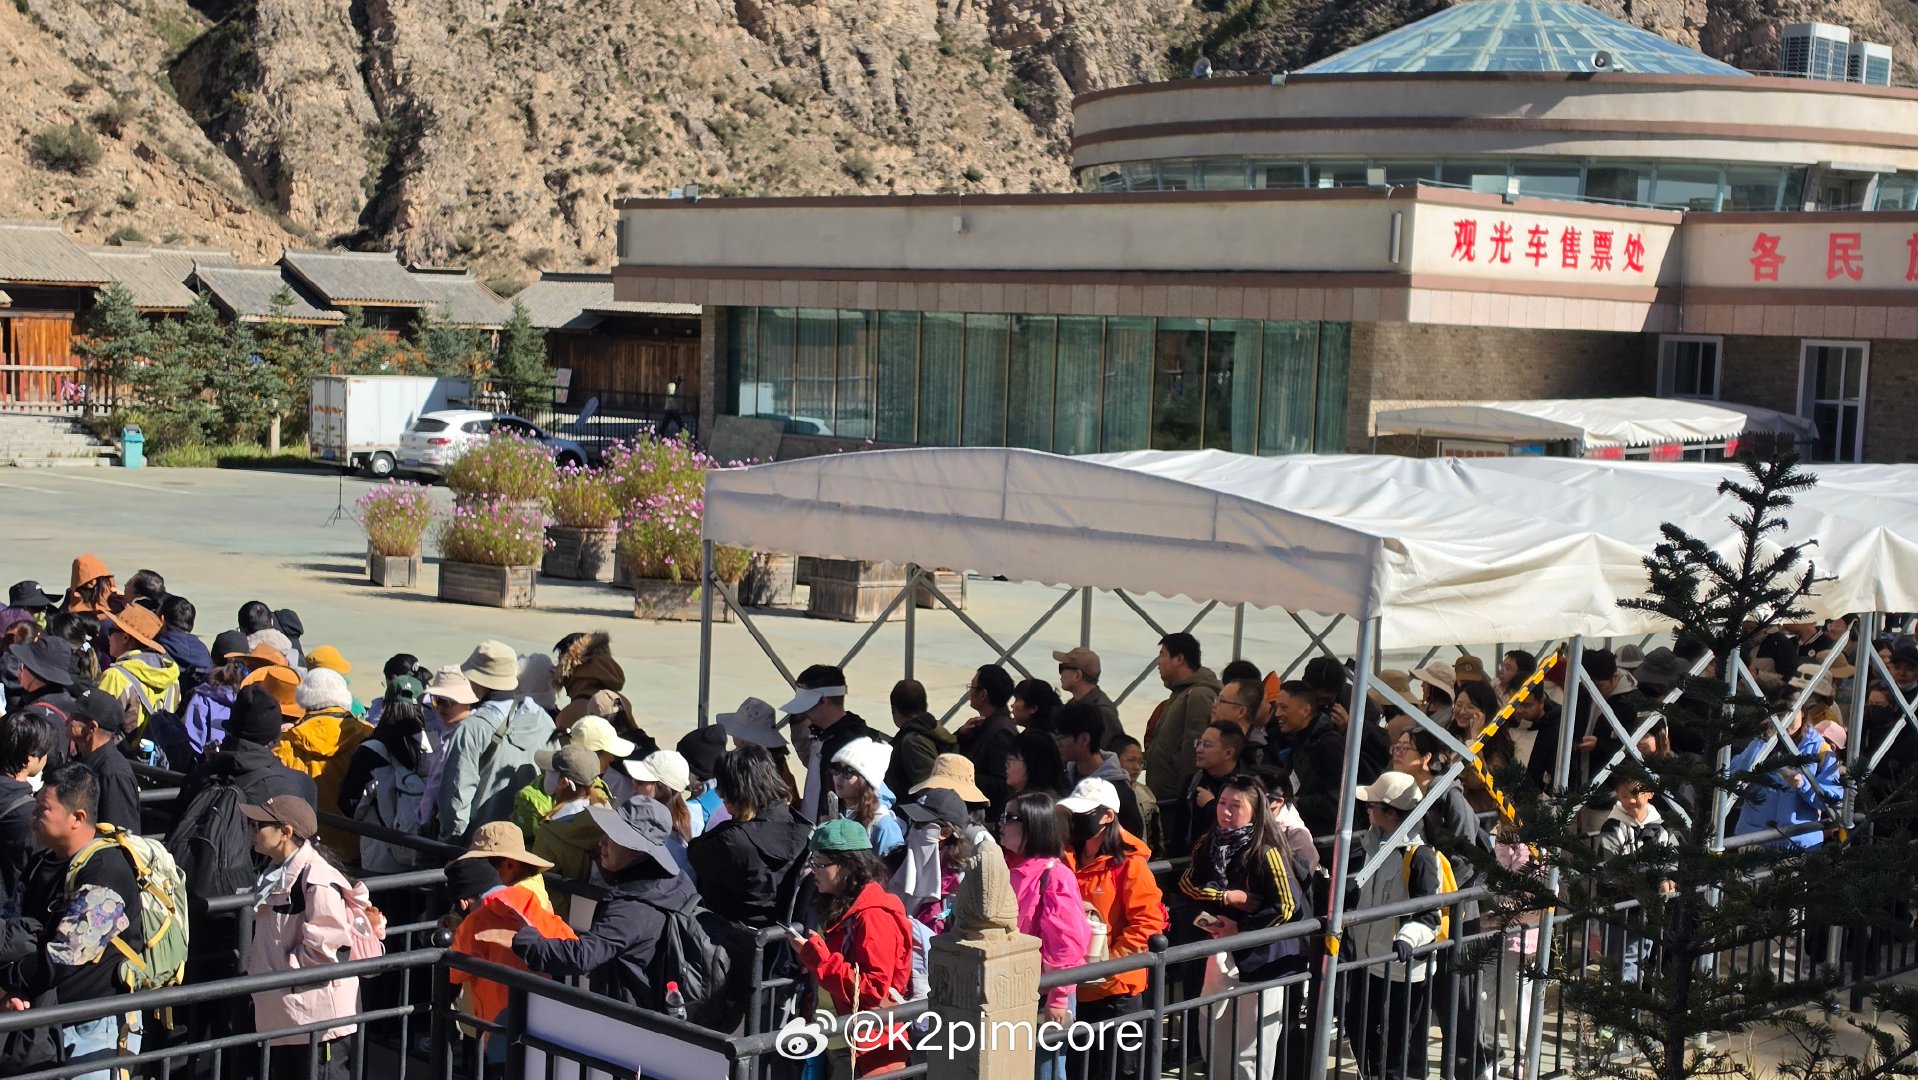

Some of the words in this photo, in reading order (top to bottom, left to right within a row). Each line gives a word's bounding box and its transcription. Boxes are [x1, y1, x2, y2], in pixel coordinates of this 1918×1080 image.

[1451, 219, 1645, 272] 观光车售票处
